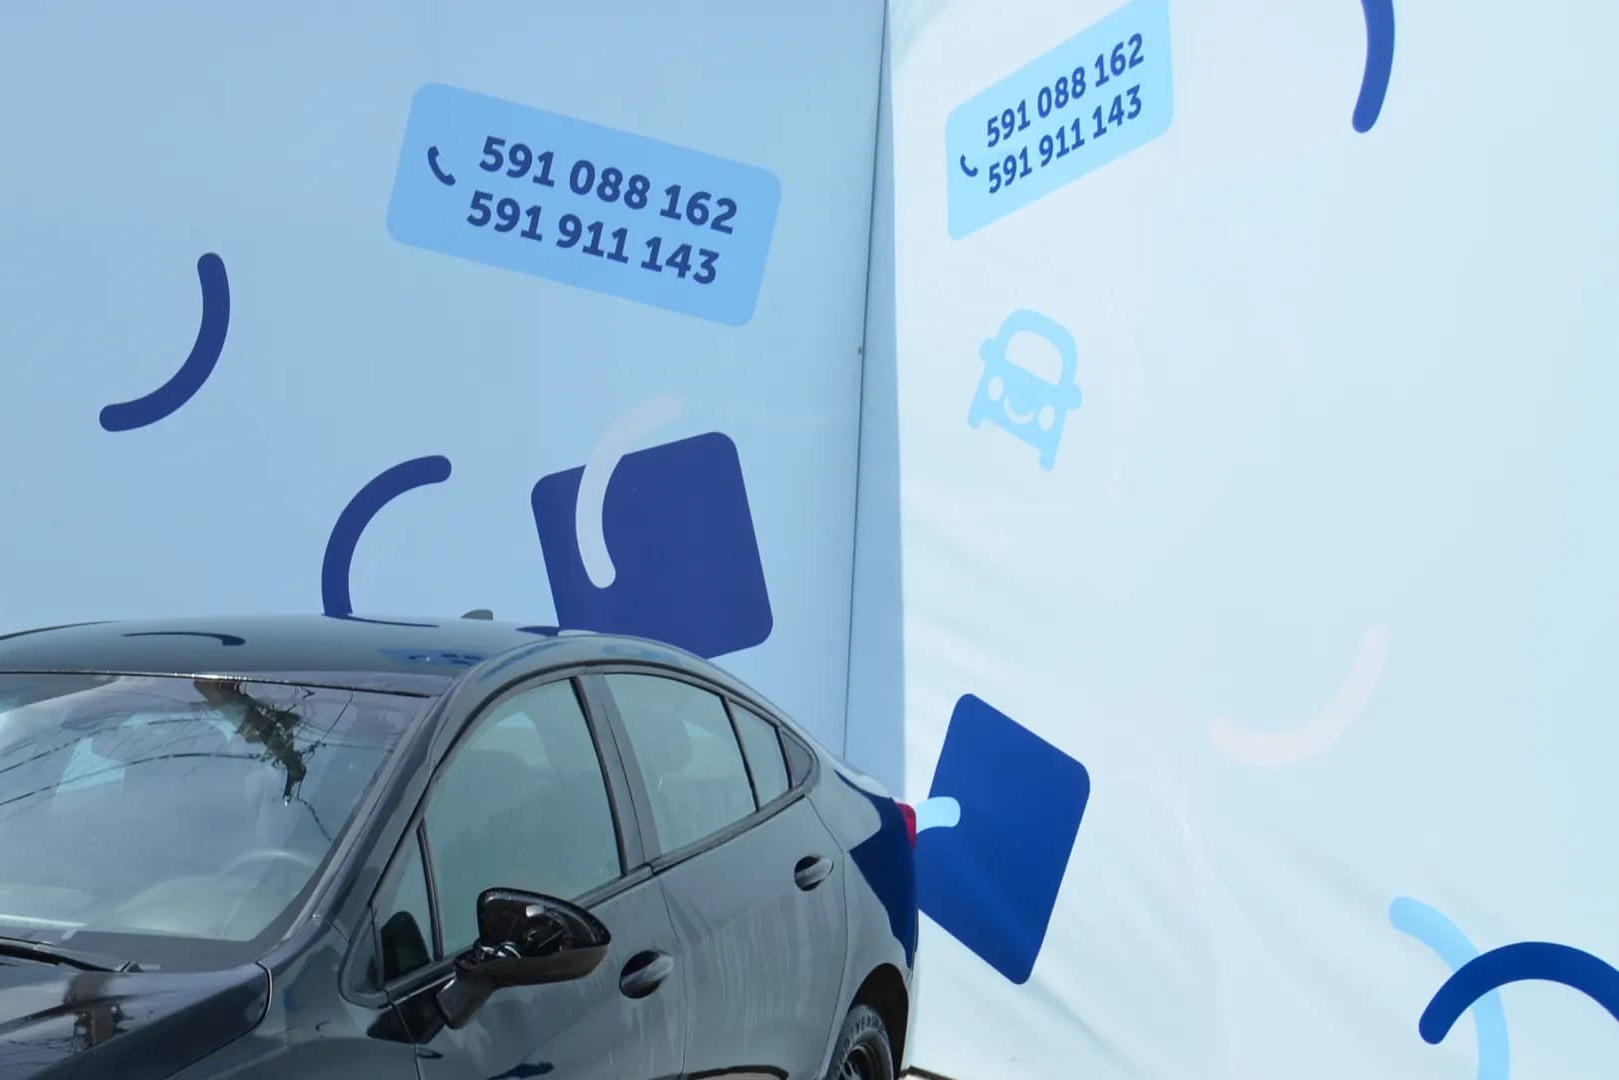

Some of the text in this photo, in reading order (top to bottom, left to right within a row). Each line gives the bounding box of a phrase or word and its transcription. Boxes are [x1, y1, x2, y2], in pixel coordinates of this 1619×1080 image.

[987, 32, 1145, 148] 591 088 162
[988, 83, 1142, 194] 591 911 143
[466, 189, 720, 285] 591 911 143
[478, 135, 738, 235] 591 088 162
